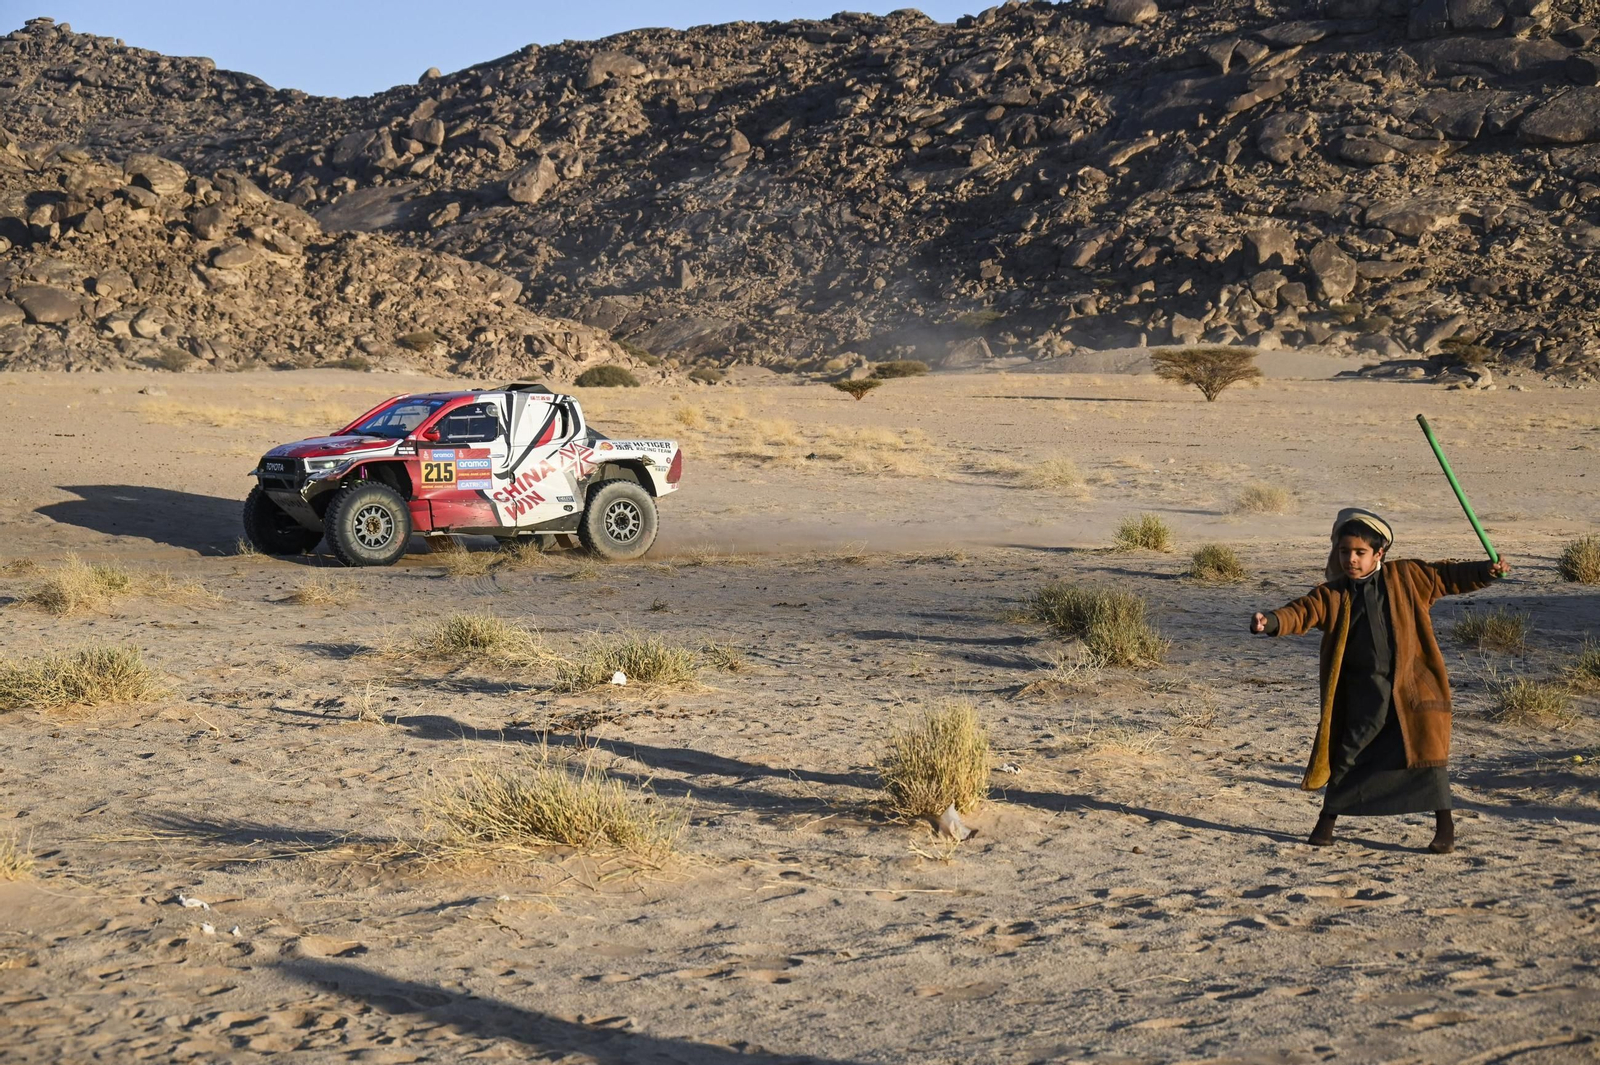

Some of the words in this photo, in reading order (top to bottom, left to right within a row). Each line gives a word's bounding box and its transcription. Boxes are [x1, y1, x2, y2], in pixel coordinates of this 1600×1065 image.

[632, 441, 671, 449] HI-TIGER
[266, 463, 284, 471] TOYOTA
[459, 460, 488, 468] aramco
[424, 463, 453, 482] 215
[493, 460, 556, 501] CHINA
[504, 491, 546, 521] WIN
